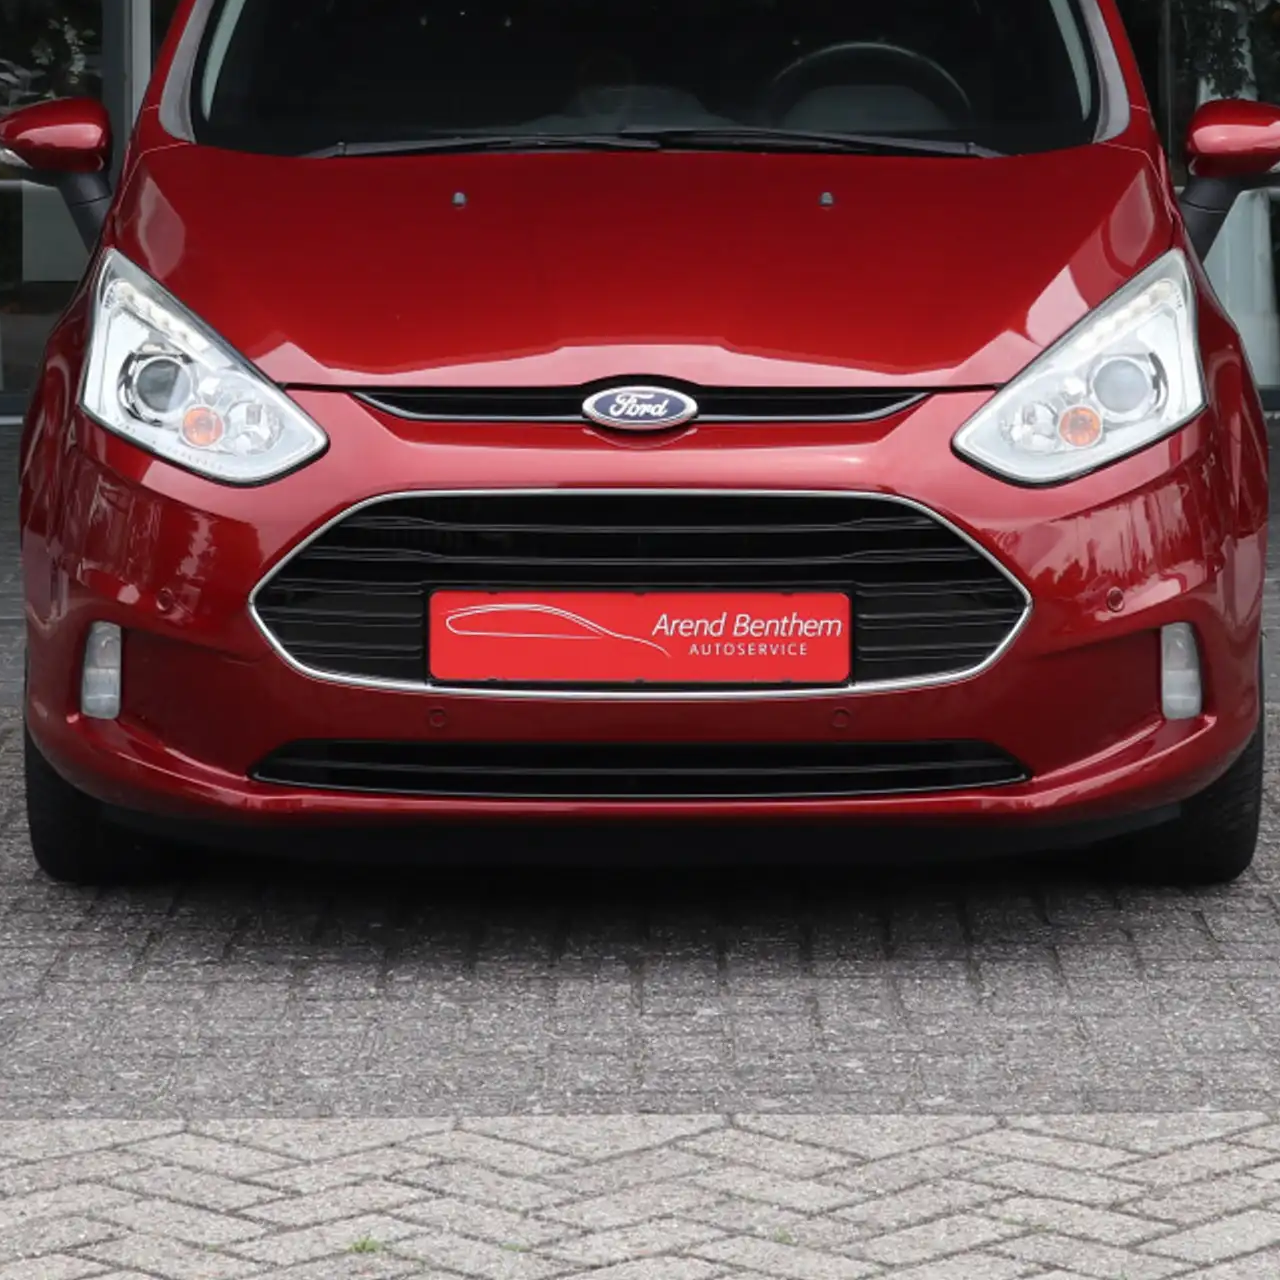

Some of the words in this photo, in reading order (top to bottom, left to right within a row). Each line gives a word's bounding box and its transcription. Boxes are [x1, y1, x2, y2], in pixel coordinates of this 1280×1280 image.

[608, 392, 670, 417] Ford
[651, 612, 728, 637] Arend
[732, 612, 843, 637] Benthem
[688, 642, 808, 656] AUTOSERVICE
